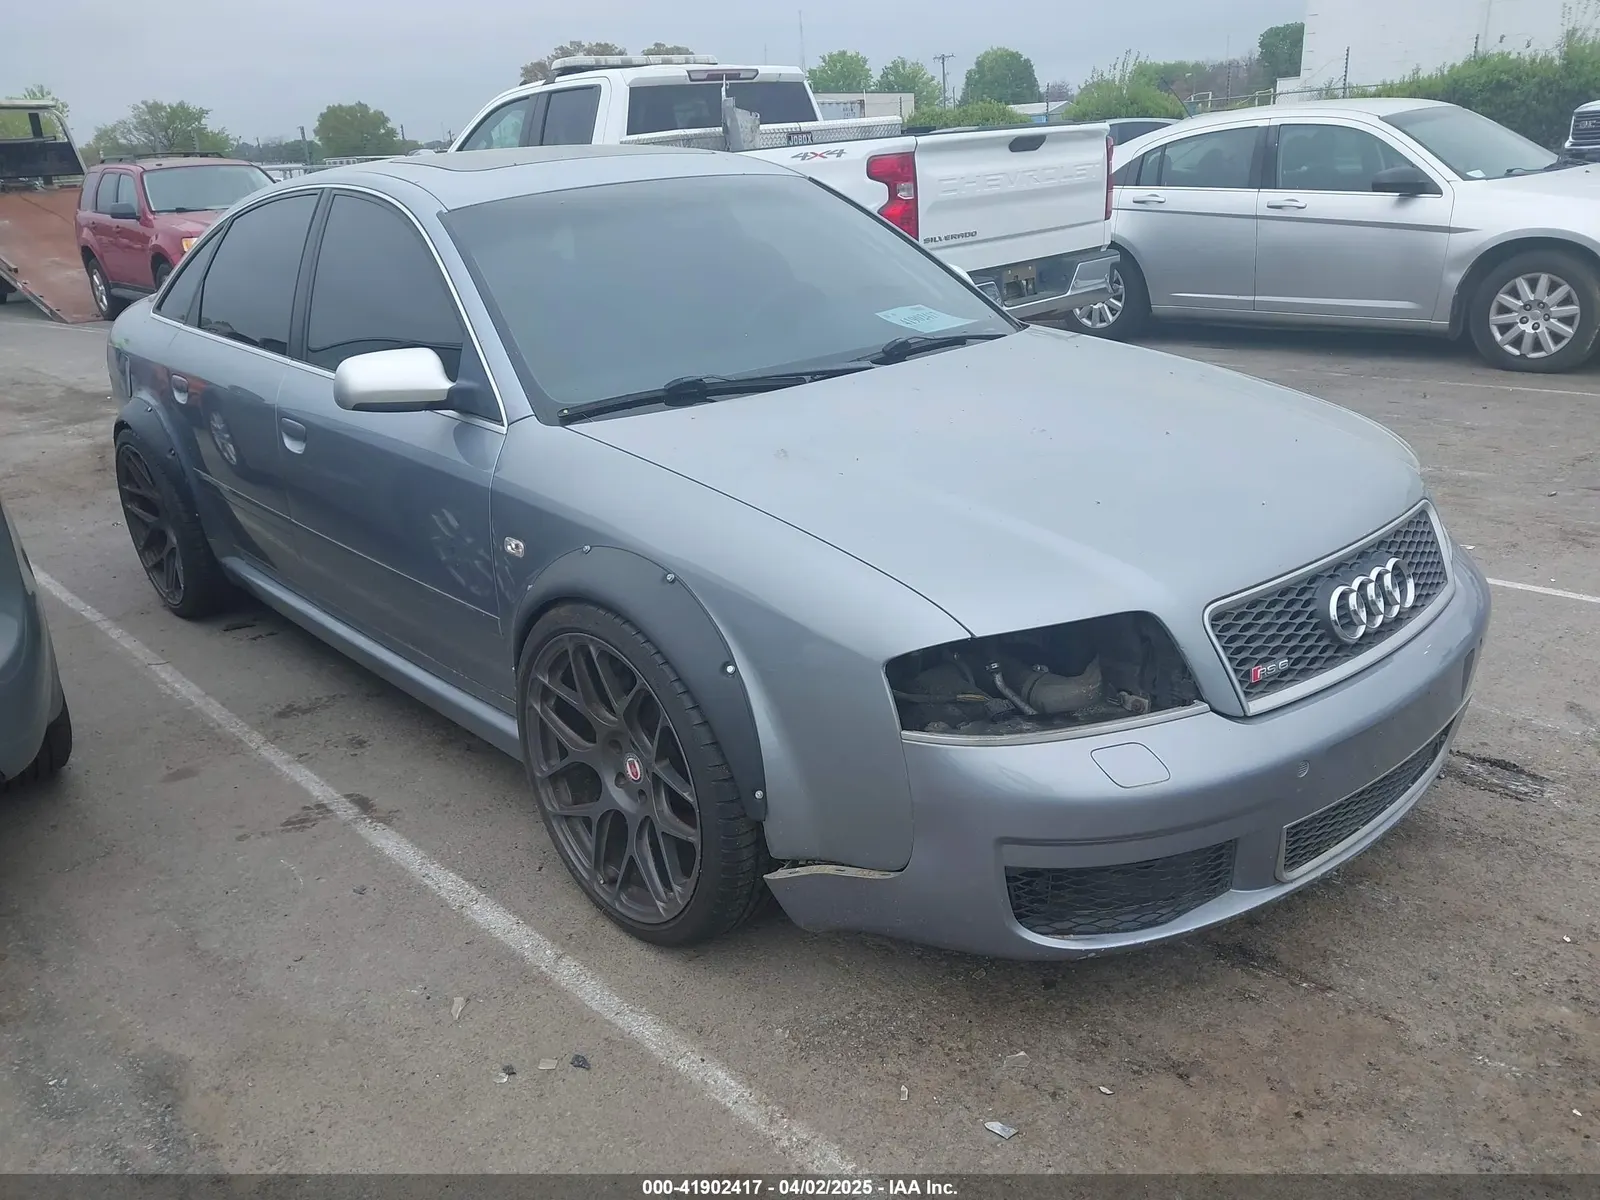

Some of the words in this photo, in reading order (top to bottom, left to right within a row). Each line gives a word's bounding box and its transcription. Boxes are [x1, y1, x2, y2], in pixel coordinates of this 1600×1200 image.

[789, 133, 813, 145] JOBOX
[938, 162, 1101, 196] CHEVROLET
[923, 231, 977, 244] SILVERADO
